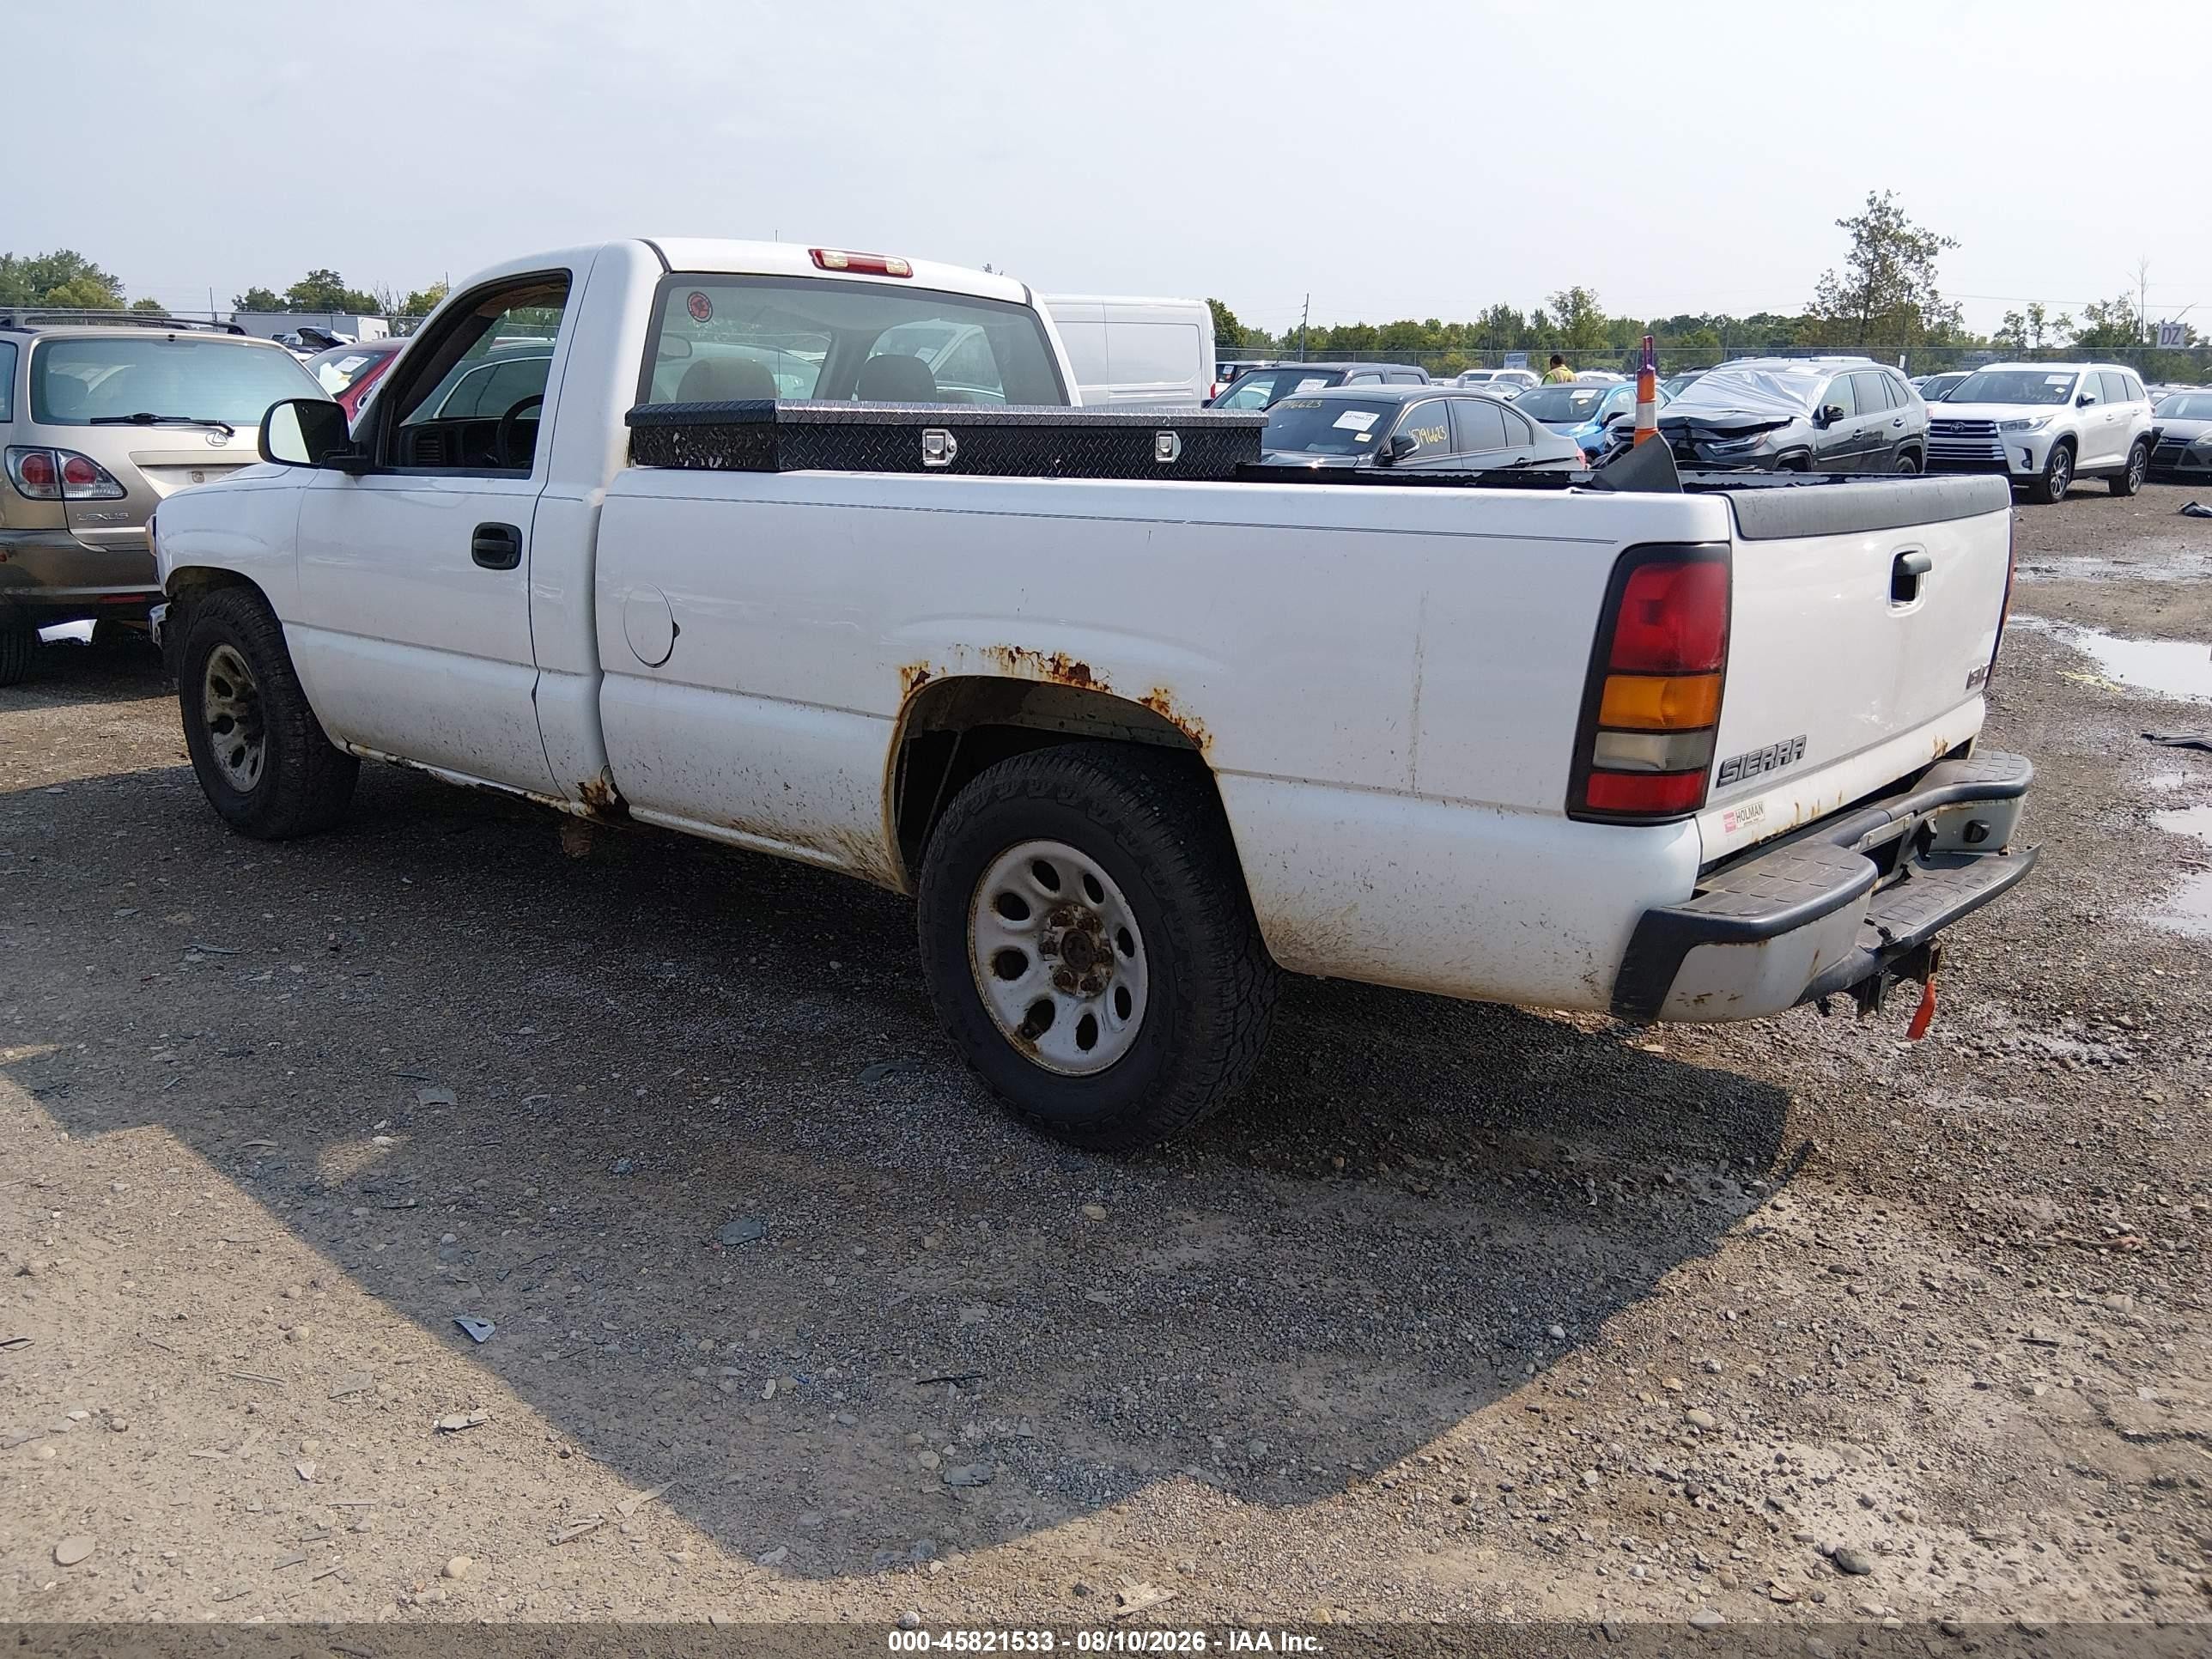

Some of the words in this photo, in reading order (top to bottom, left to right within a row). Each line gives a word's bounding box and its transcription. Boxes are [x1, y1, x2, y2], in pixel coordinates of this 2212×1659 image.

[2161, 327, 2181, 345] DZ
[1716, 734, 1807, 788] SIERRA
[1735, 803, 1764, 823] HOLMAN
